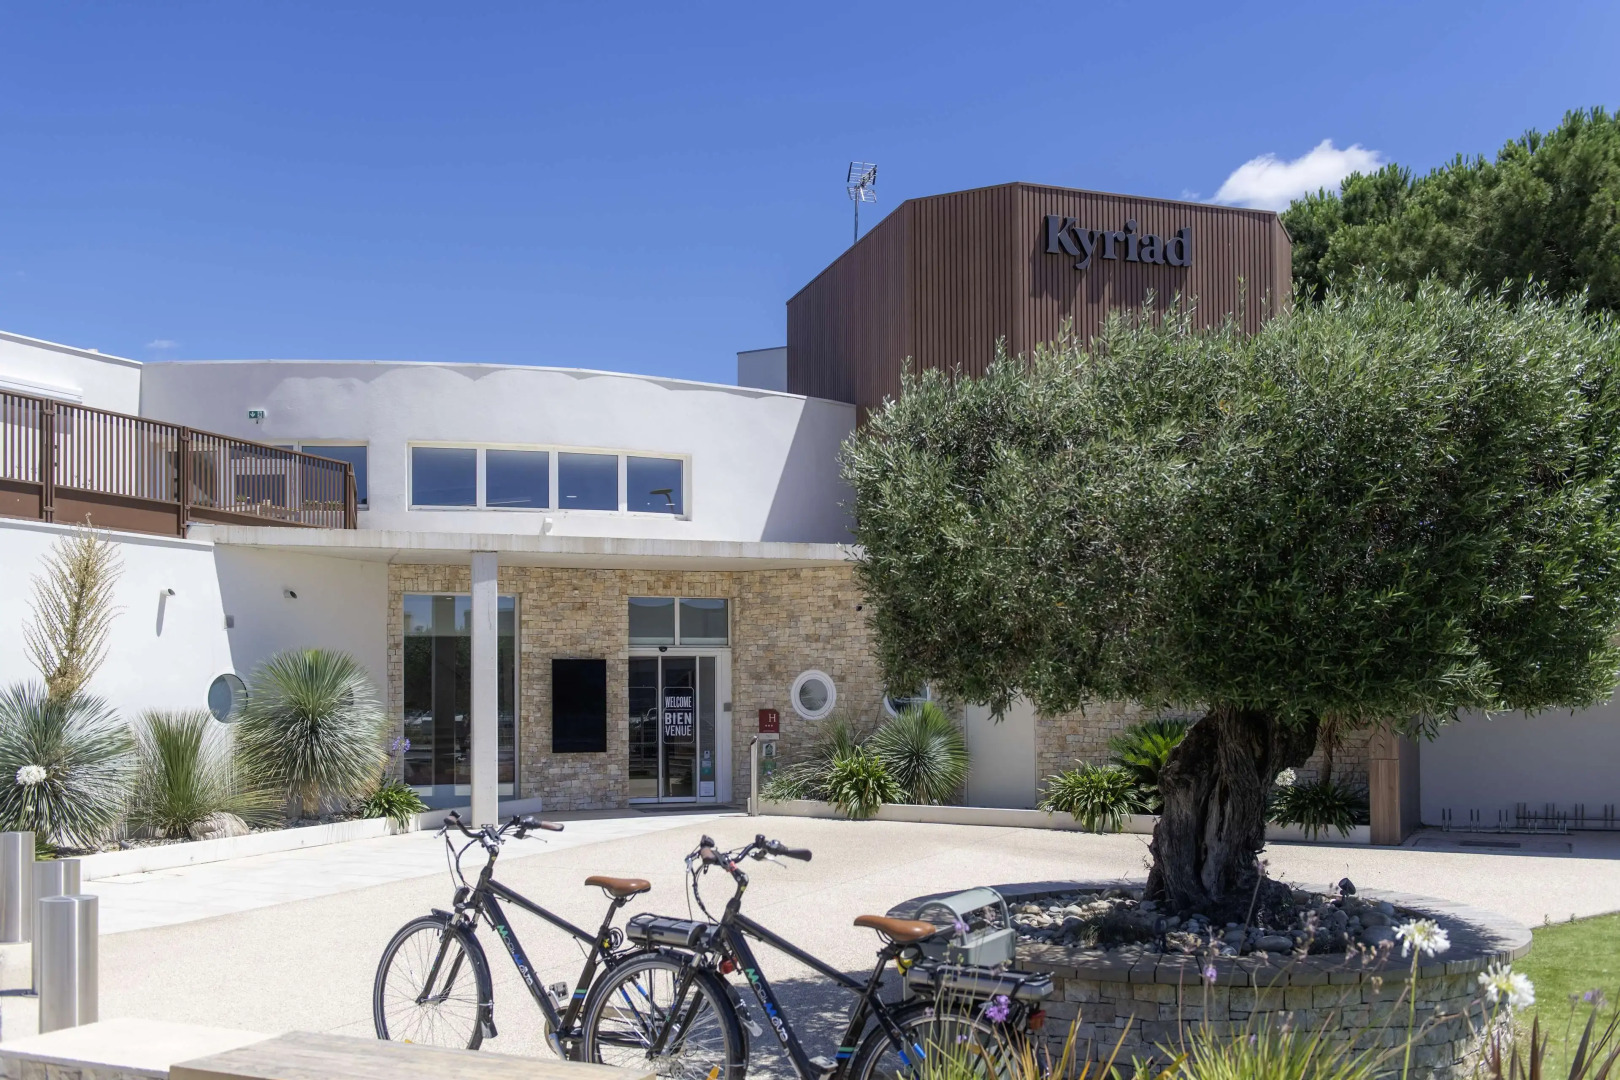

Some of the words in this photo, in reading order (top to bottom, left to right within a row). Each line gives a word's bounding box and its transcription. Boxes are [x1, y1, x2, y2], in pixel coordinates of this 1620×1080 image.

[1045, 214, 1192, 270] Kyriad
[664, 696, 692, 708] WELCOME
[664, 712, 692, 725] BIEN
[768, 713, 776, 723] H
[664, 725, 692, 737] VENUE
